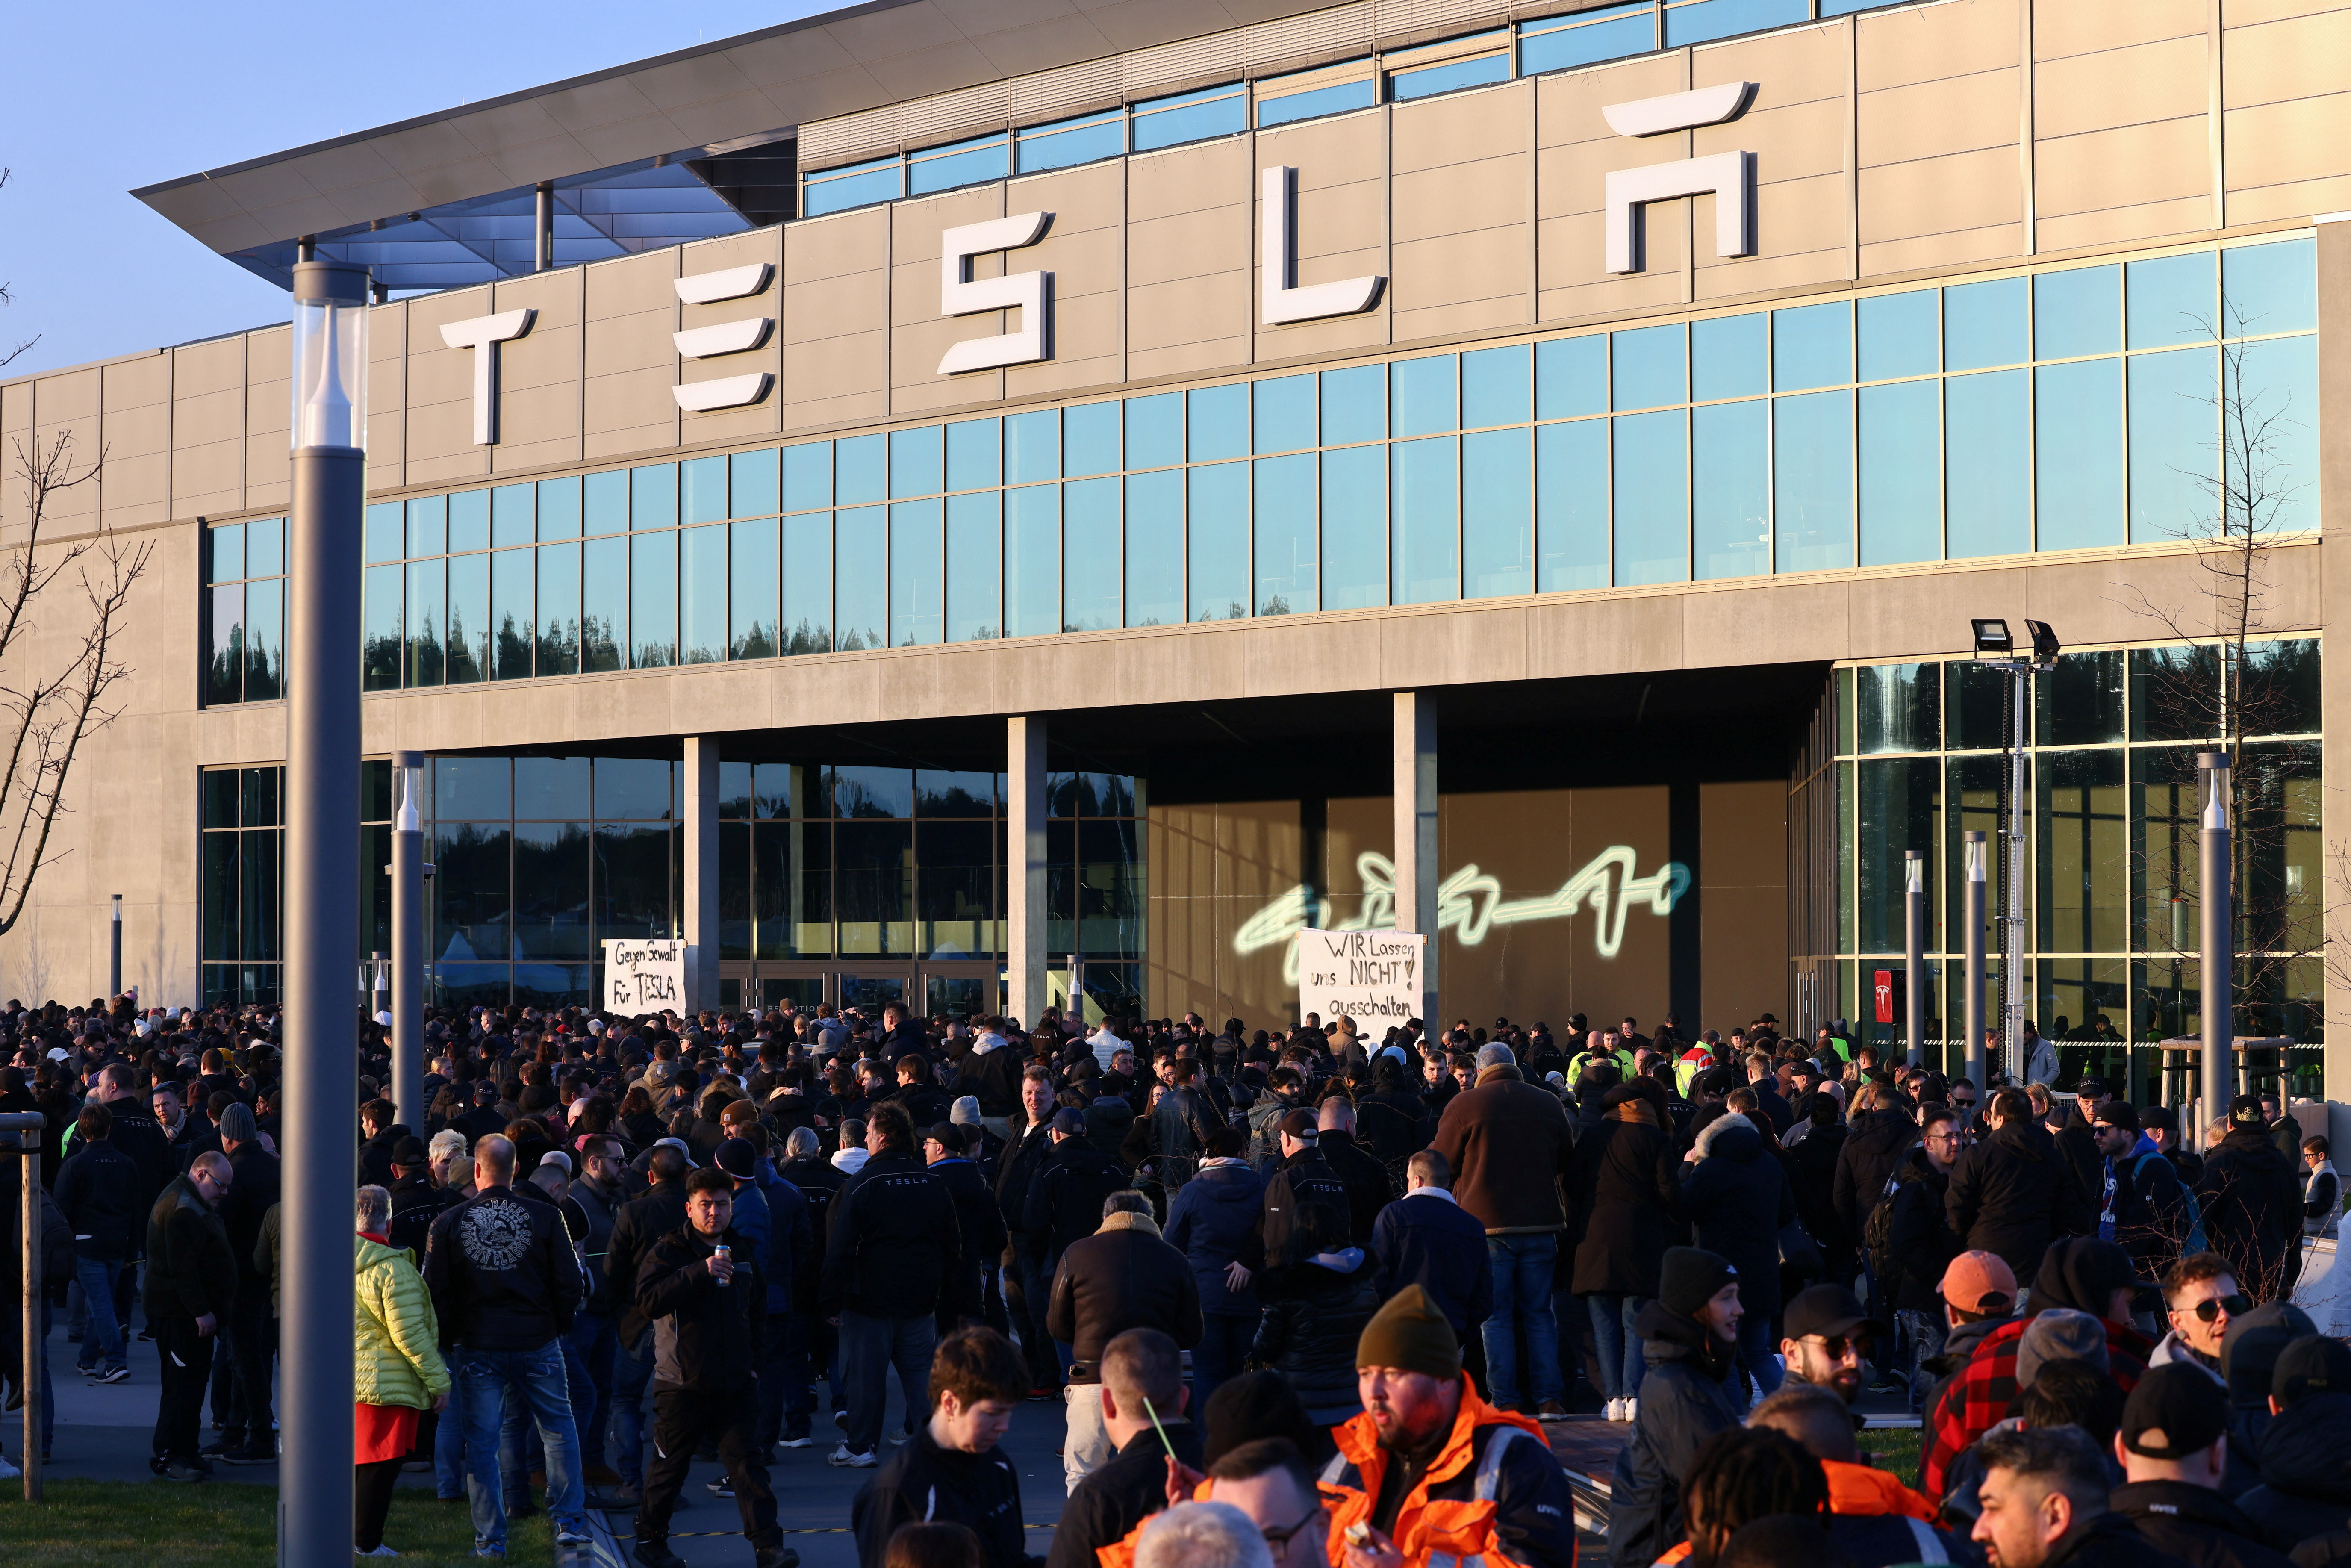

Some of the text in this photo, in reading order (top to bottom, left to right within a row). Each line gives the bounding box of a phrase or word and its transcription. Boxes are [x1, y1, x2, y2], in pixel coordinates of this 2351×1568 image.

[440, 80, 1752, 445] TESLA
[616, 940, 678, 971] Gegen Gewalt
[1325, 933, 1414, 958] WIR Lassen
[631, 972, 677, 1006] TESLA
[1310, 972, 1336, 986] uns
[1329, 992, 1414, 1018] ausschalten
[885, 1178, 928, 1186] TESLA
[491, 1199, 530, 1223] RACER
[461, 1220, 491, 1265] MODERN
[493, 1229, 532, 1266] CLASSES
